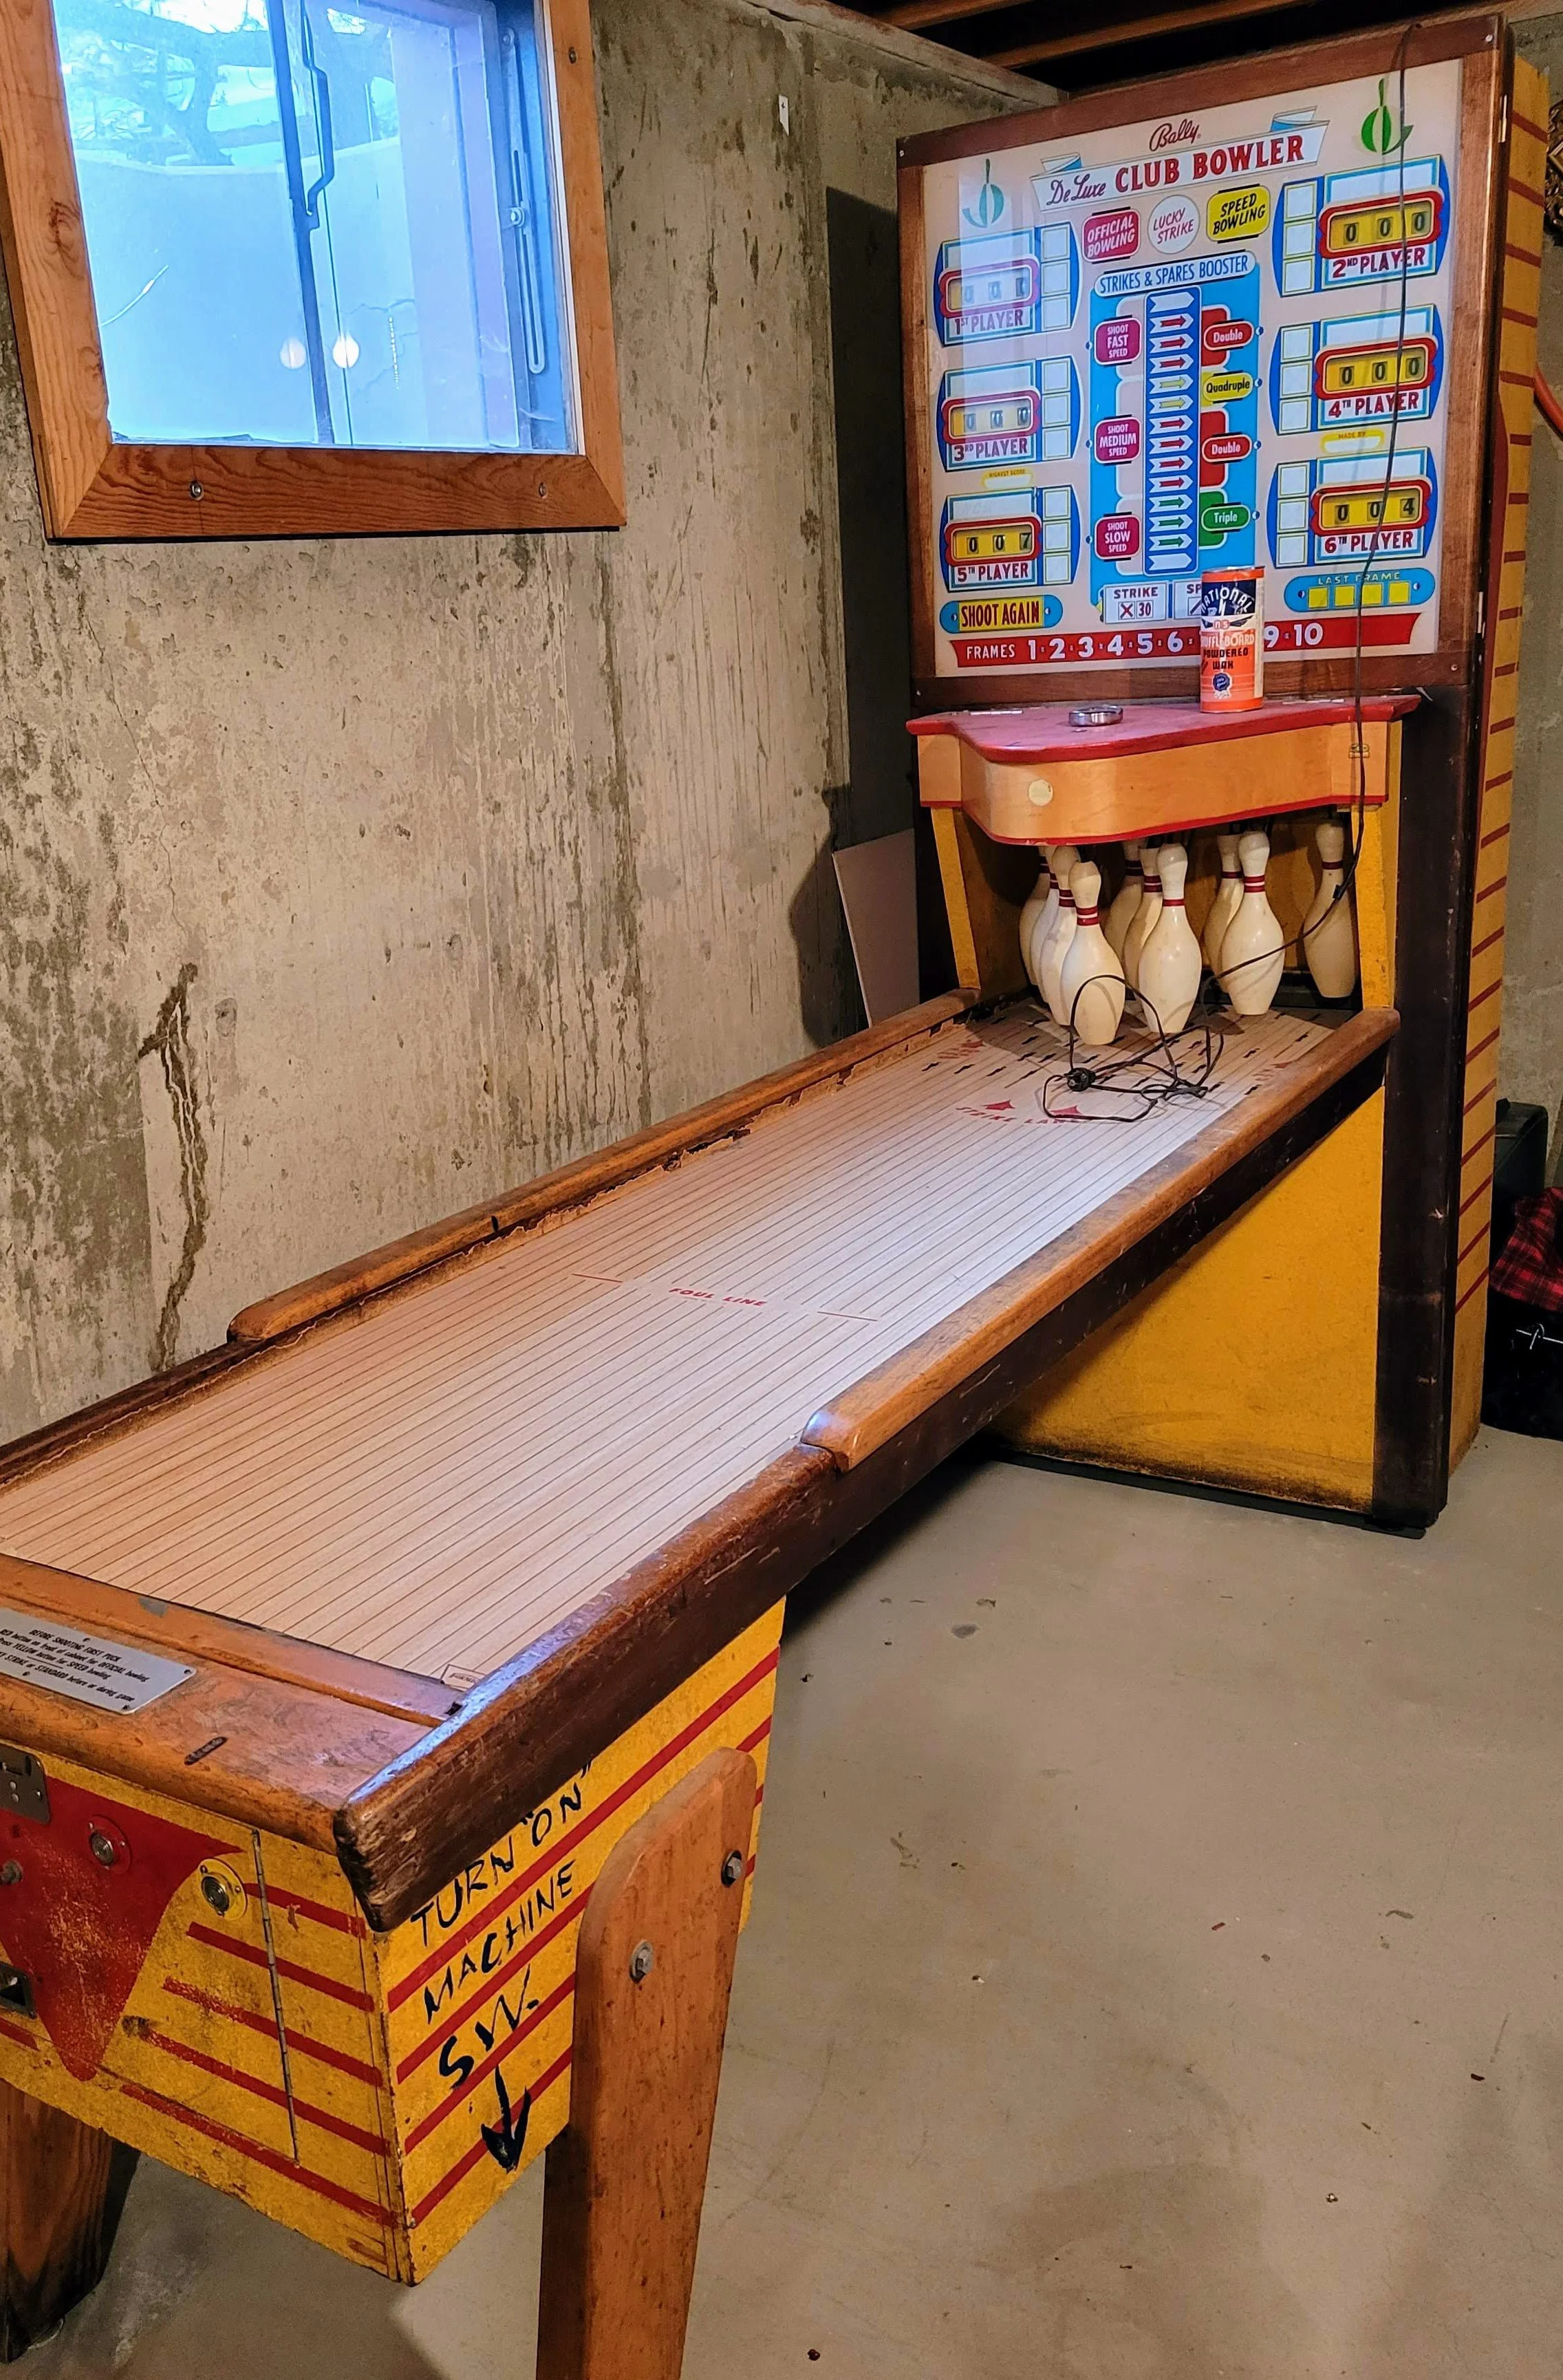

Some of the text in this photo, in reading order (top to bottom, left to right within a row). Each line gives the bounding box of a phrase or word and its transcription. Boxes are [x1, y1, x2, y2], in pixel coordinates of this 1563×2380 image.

[1150, 118, 1199, 151] Bally
[1115, 158, 1180, 193] CLUB
[1193, 135, 1304, 180] BOWLER
[1220, 193, 1258, 217] SPEED
[1153, 208, 1186, 231] LUCKY
[1213, 204, 1266, 235] BOWLING
[1088, 221, 1134, 242] OFFICIAL
[1156, 222, 1194, 244] STRIKE
[1088, 230, 1136, 257] BOWLING
[1333, 247, 1426, 279] 2ND PLAYER
[1100, 255, 1248, 294] STRIKES & SPARES BOOSTER
[955, 309, 1024, 335] 1ST PLAYER
[1106, 324, 1129, 335] SHOOT
[1107, 334, 1129, 349] FAST
[1213, 329, 1244, 343] Double
[1108, 347, 1128, 358] SPEED
[1206, 378, 1251, 394] Quadruple
[1328, 392, 1419, 418] 4TH PLAYER
[1108, 424, 1129, 435] SHOOT
[954, 438, 1028, 461] 3RD PLAYER
[1100, 433, 1137, 447] MEDIUM
[1211, 442, 1241, 455] Double
[1108, 447, 1128, 457] SPEED
[1108, 521, 1128, 531] SHOOT
[1214, 511, 1238, 523] Triple
[1105, 530, 1131, 544] SLOW
[1325, 531, 1414, 553] 6TH PLAYER
[1108, 542, 1128, 553] SPEED
[957, 563, 1028, 583] 5TH PLAYER
[1319, 572, 1401, 585] LAST FRAME
[1113, 587, 1158, 599] STRIKE
[961, 600, 1040, 628] SHOOT AGAIN
[1138, 601, 1152, 617] 30
[967, 643, 1015, 659] FRAMES
[1028, 640, 1037, 660] 1
[1049, 638, 1066, 659] 2
[1078, 636, 1095, 658] 3
[1108, 634, 1124, 656] 4
[1136, 633, 1154, 654] 5
[1167, 631, 1183, 653] 6
[1294, 623, 1324, 646] 10
[669, 1287, 768, 1307] FOUL LINE
[411, 1836, 515, 1947] TURN
[424, 1859, 576, 2024] MACHINE
